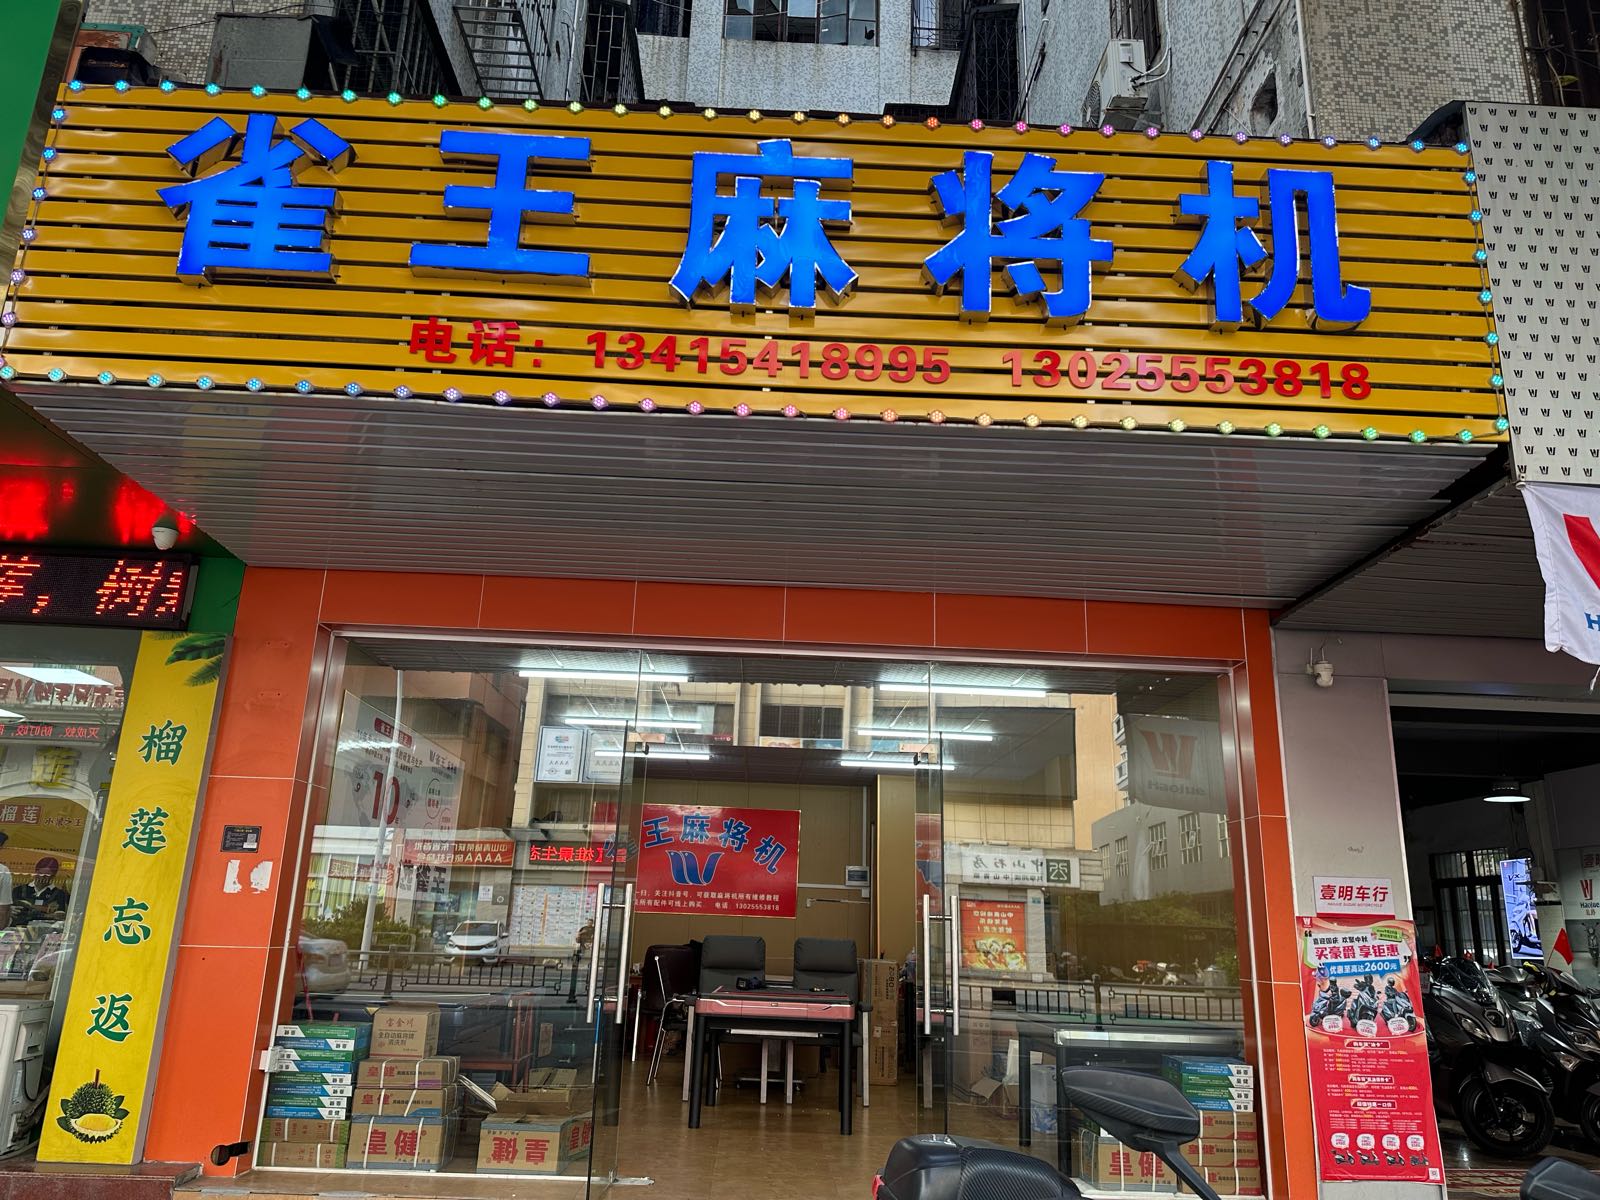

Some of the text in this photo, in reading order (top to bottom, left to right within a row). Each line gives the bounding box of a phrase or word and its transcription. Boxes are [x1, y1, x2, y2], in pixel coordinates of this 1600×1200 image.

[158, 113, 1371, 329] 雀王麻将机
[586, 331, 951, 385] 13415418995
[1001, 351, 1371, 399] 13025553818
[606, 812, 787, 875] 王麻将机
[86, 719, 188, 1043] 榴莲忘返
[1320, 884, 1389, 902] 壹明车行
[1315, 943, 1400, 960] 买豪爵 享钜惠
[361, 1129, 420, 1157] 皇健
[490, 1136, 550, 1165] 皇健
[1109, 1149, 1165, 1177] 皇健
